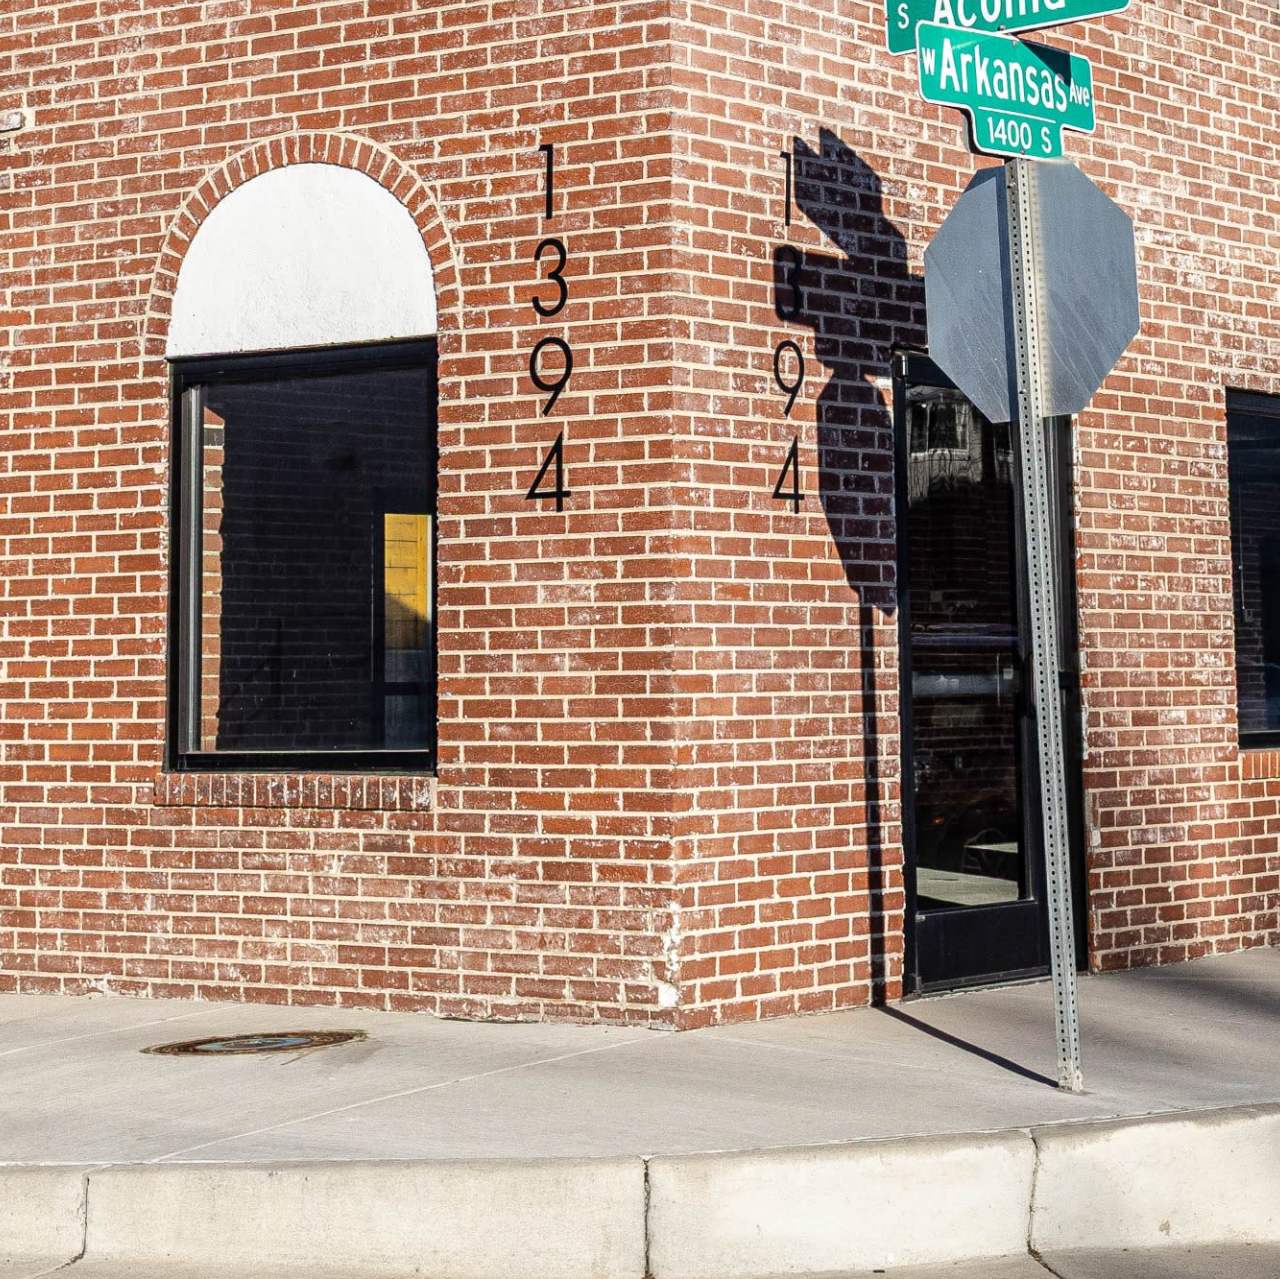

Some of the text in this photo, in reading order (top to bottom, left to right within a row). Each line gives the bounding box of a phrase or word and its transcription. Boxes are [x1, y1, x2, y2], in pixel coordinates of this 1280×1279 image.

[897, 3, 910, 29] S
[921, 38, 1090, 113] W Arkansas Ave
[987, 117, 1052, 154] 1400 S
[525, 144, 574, 513] 1394
[771, 151, 805, 515] 1394
